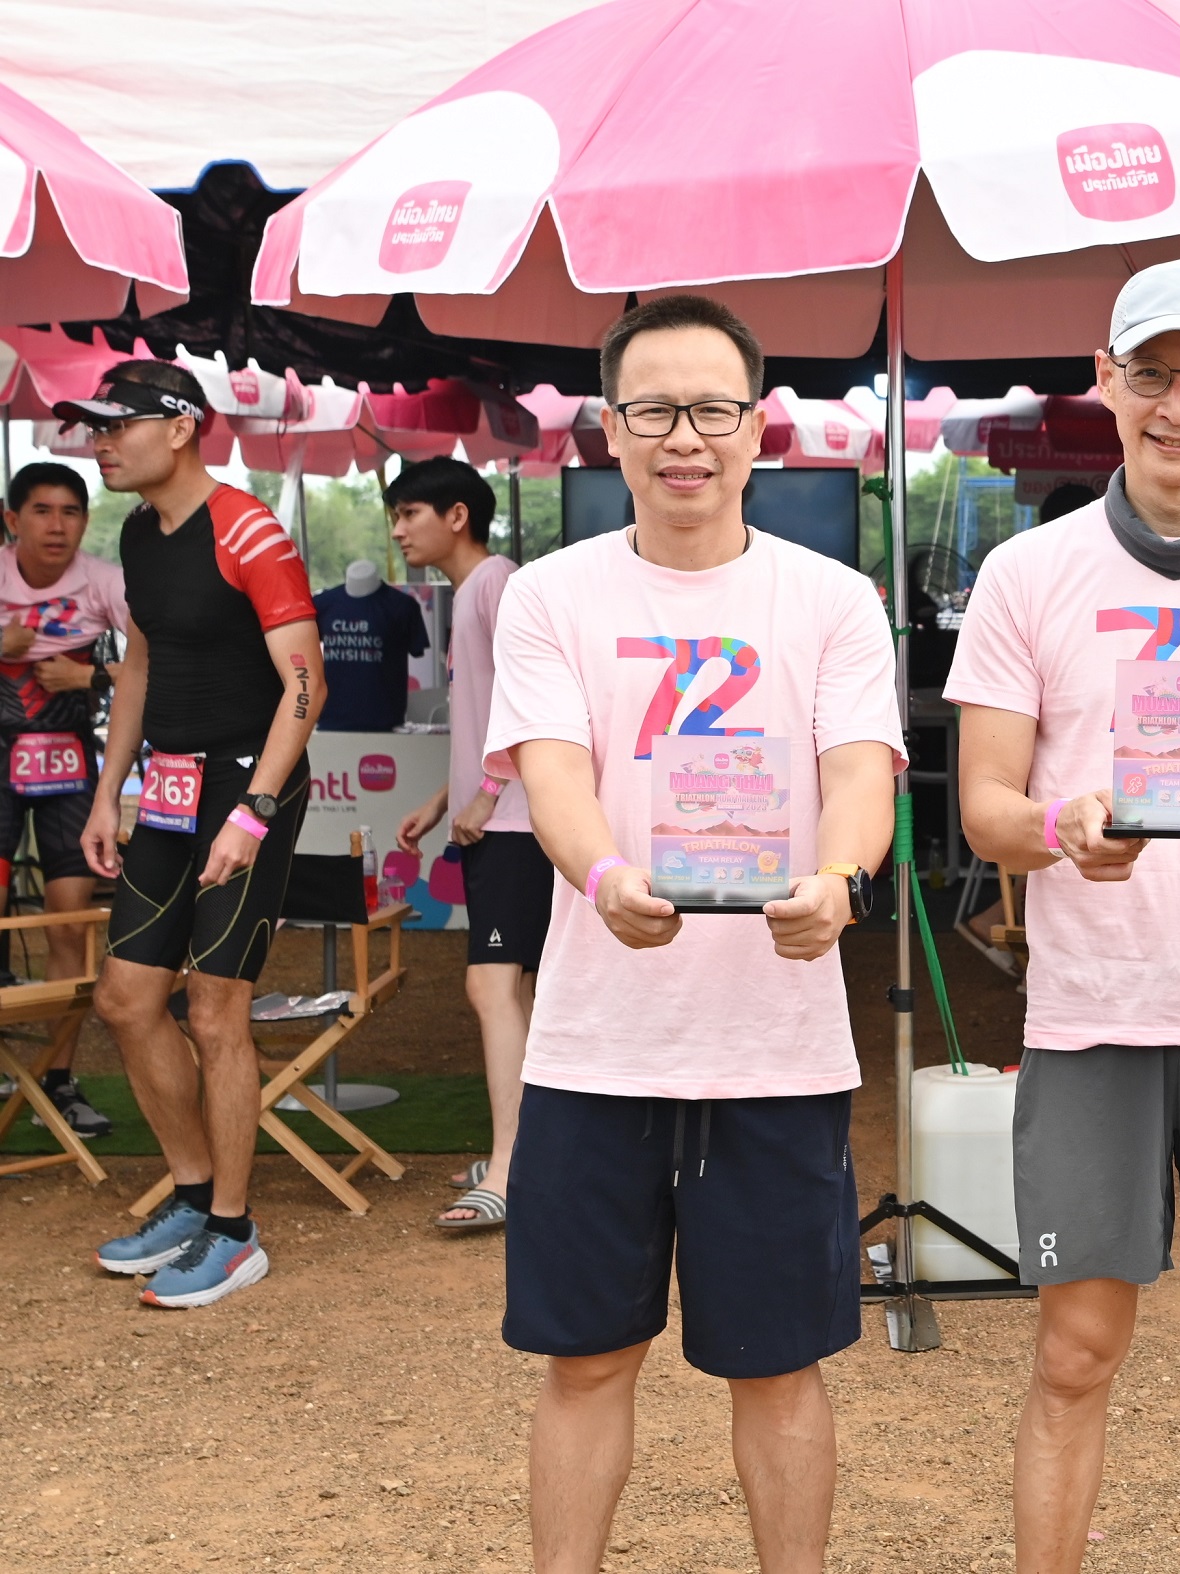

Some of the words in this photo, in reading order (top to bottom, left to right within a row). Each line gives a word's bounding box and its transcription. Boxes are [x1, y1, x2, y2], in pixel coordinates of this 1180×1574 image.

[1065, 142, 1162, 174] เมืองไทย
[392, 200, 459, 226] เมืองไทย
[332, 620, 369, 633] CLUB
[294, 667, 310, 720] 2163
[617, 636, 764, 761] 72
[16, 748, 79, 776] 2159
[144, 770, 196, 807] 2163
[681, 837, 761, 855] TRIATHLON
[699, 856, 720, 864] TEAM
[720, 856, 744, 864] RELAY
